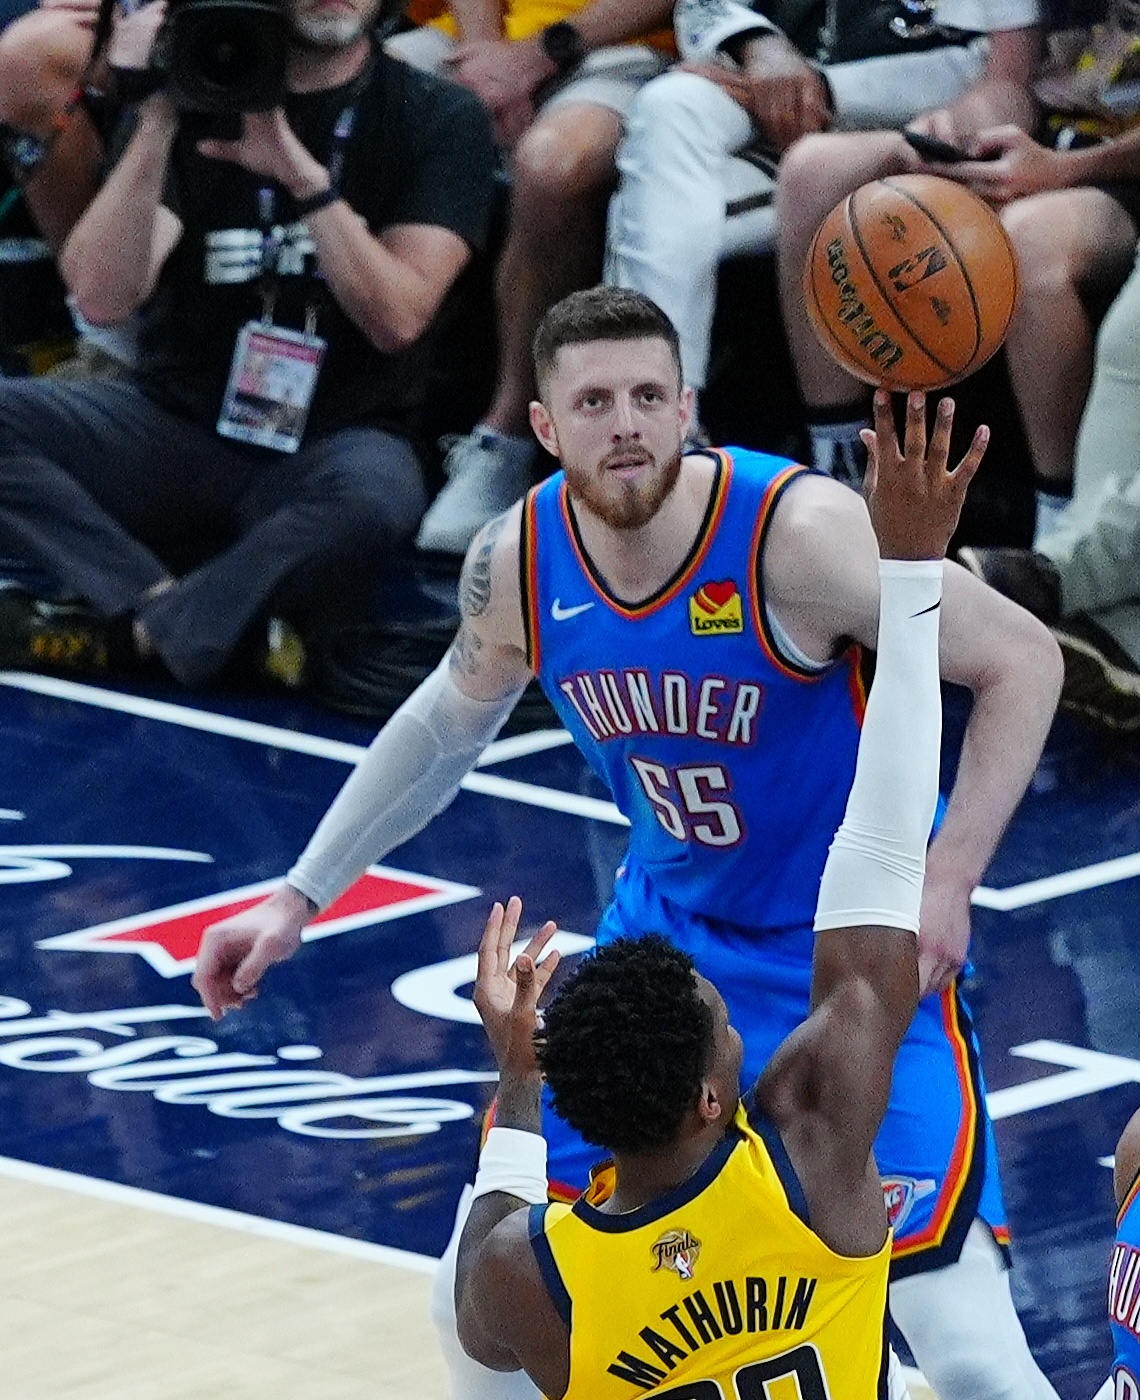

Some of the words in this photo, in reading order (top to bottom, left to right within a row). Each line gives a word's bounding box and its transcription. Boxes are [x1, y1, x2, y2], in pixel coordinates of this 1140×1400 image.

[826, 234, 904, 372] Wilson
[559, 670, 761, 745] THUNDER
[628, 755, 746, 845] 55
[0, 996, 500, 1139] tside
[651, 1231, 699, 1271] Finals
[606, 1275, 818, 1390] MATHURIN
